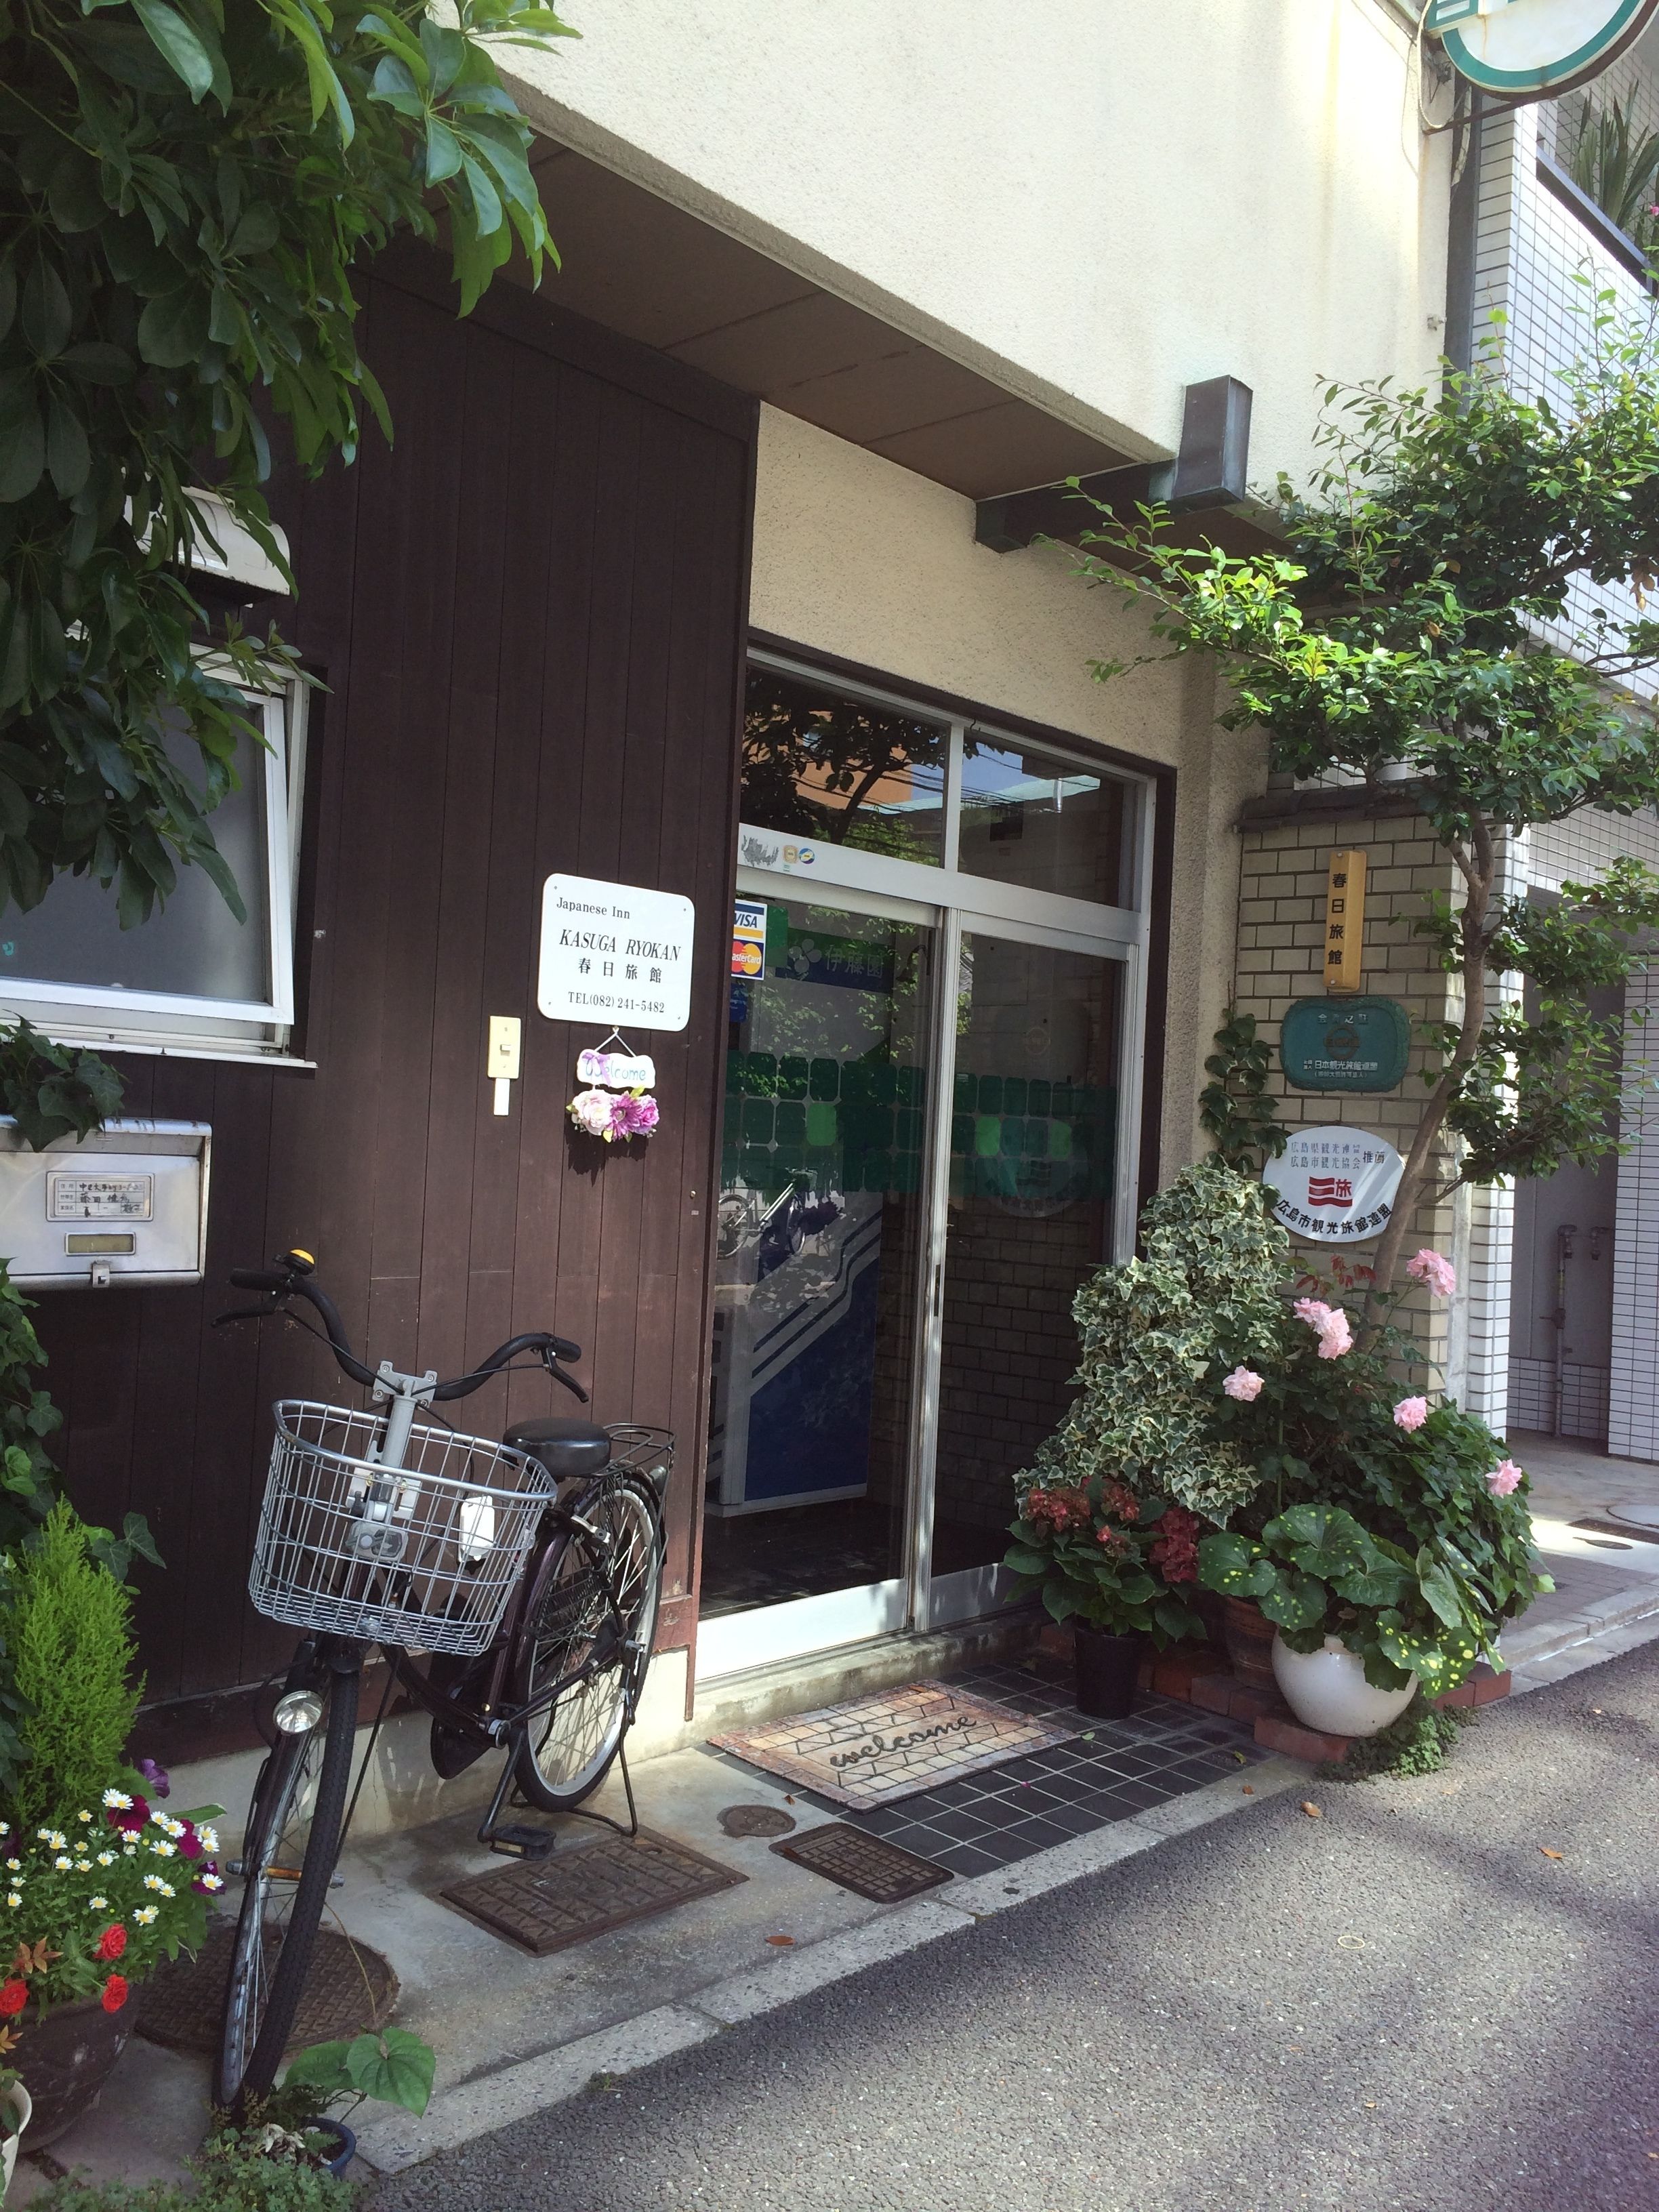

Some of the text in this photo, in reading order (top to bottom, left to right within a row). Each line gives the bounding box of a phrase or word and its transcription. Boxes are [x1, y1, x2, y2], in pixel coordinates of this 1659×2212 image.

[556, 897, 630, 919] Japanese Inn
[735, 912, 757, 928] VISA
[1327, 872, 1348, 965] 春日旅館
[559, 929, 681, 961] KASUGA RYOKAN
[732, 953, 762, 964] asterCard
[578, 958, 661, 983] 春日旅館
[825, 944, 883, 978] 伊藤園
[1336, 1179, 1352, 1197] 旅
[1276, 1200, 1392, 1235] 広島市観光旅館連盟
[830, 1716, 977, 1767] welcome
